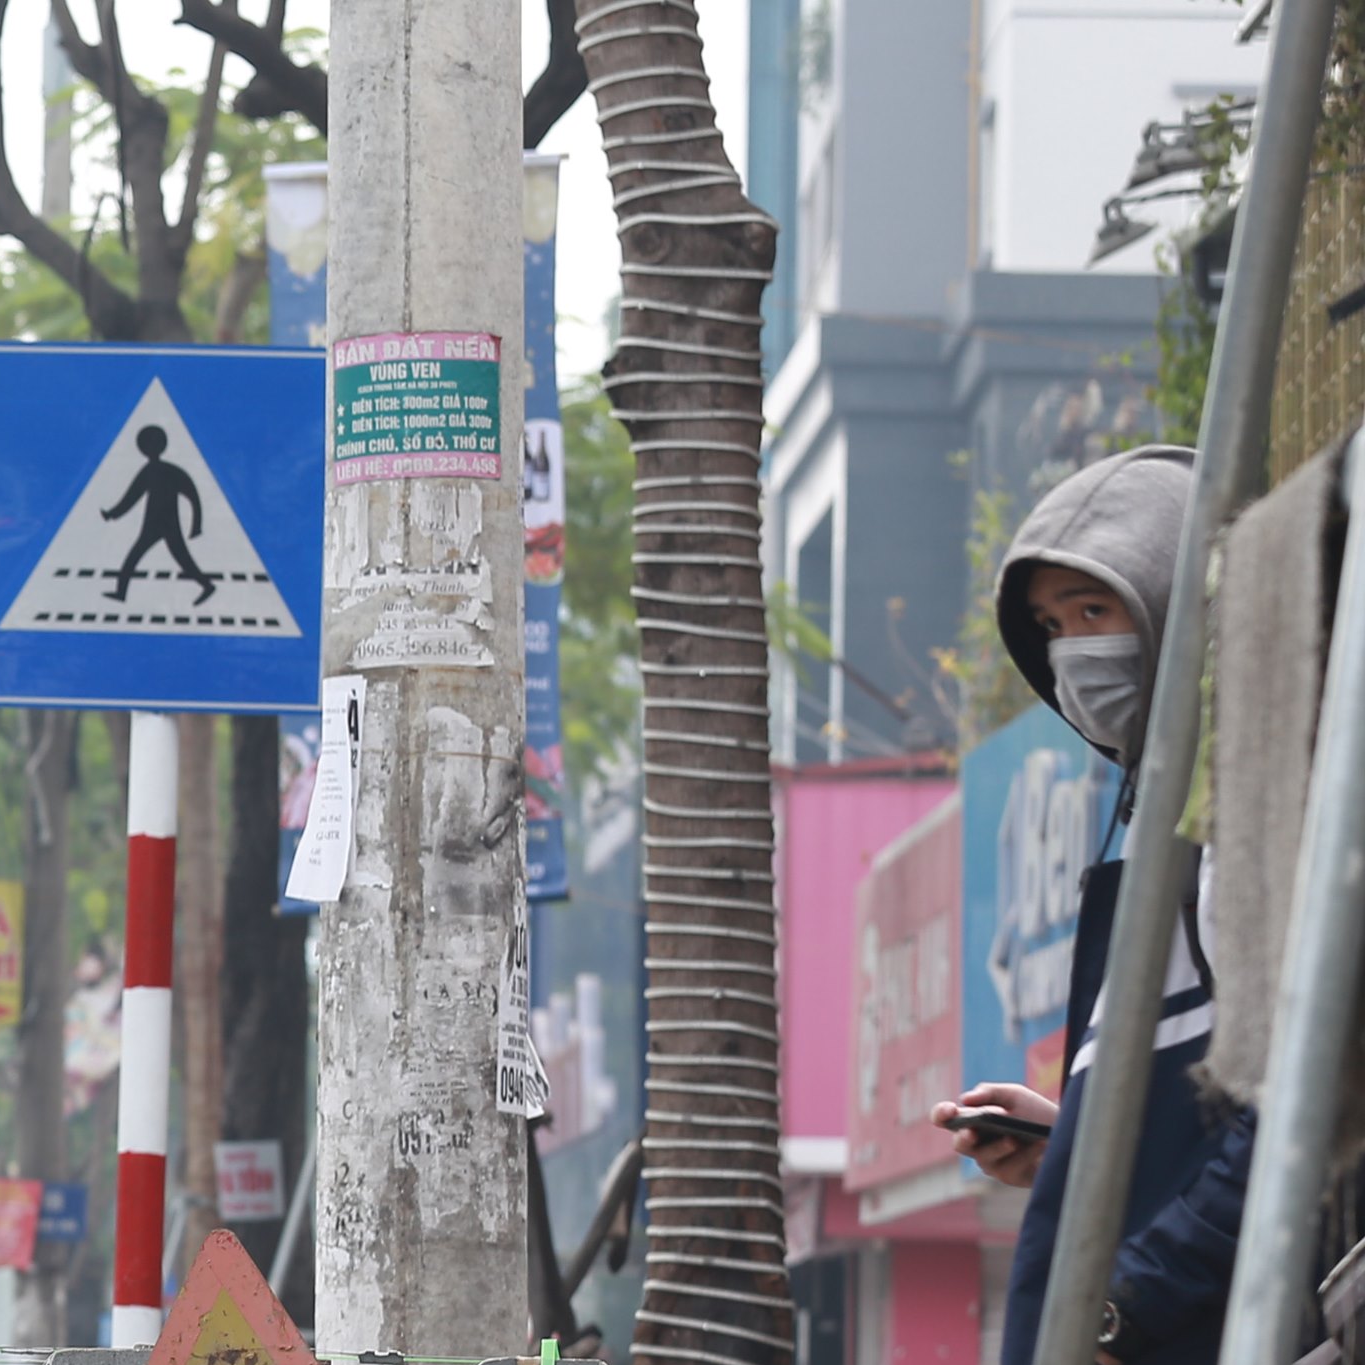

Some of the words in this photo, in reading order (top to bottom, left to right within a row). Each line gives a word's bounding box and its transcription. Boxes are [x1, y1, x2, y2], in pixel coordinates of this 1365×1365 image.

[370, 361, 407, 382] VÙNG
[411, 361, 441, 379] VEN
[442, 392, 461, 409] GIÁ
[403, 414, 446, 428] 1000m2
[448, 411, 467, 427] GIÁ
[336, 438, 366, 458] CHÍNH
